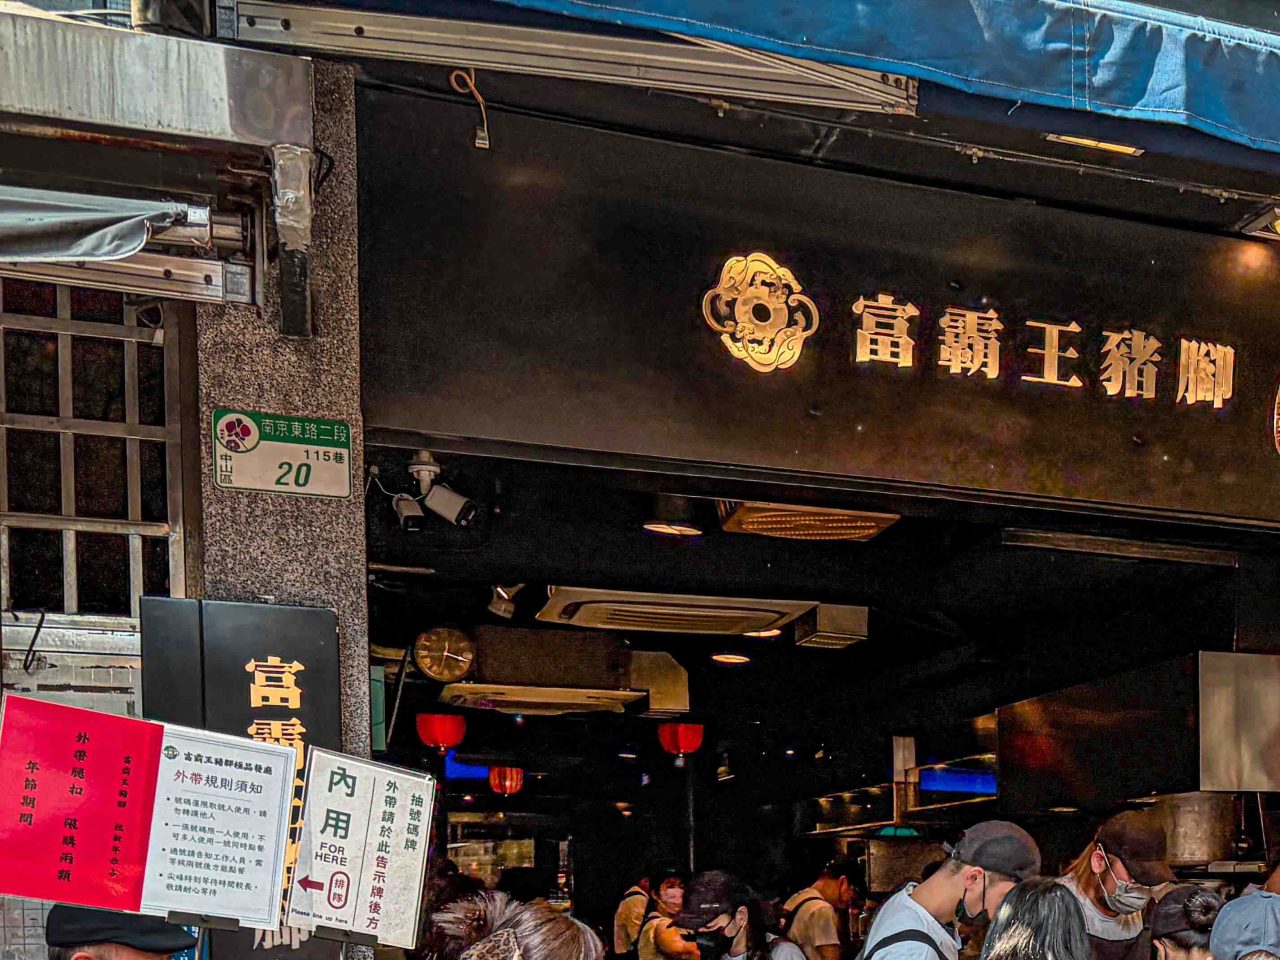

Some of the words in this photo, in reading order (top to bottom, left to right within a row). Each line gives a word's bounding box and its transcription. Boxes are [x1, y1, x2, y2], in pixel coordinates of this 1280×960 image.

[851, 293, 1235, 409] 富霸王豬腳
[261, 419, 347, 442] 南京東路二段
[220, 453, 233, 485] 中山區
[303, 449, 345, 464] 115巷
[275, 461, 312, 488] 20
[174, 769, 263, 794] 外帶規則須知
[319, 766, 357, 840] 內用
[403, 793, 424, 852] 抽號碼牌
[314, 851, 348, 867] HERE
[320, 842, 345, 855] FOR
[366, 780, 399, 930] 外帶請於此告示牌後方
[332, 878, 345, 903] 排隊
